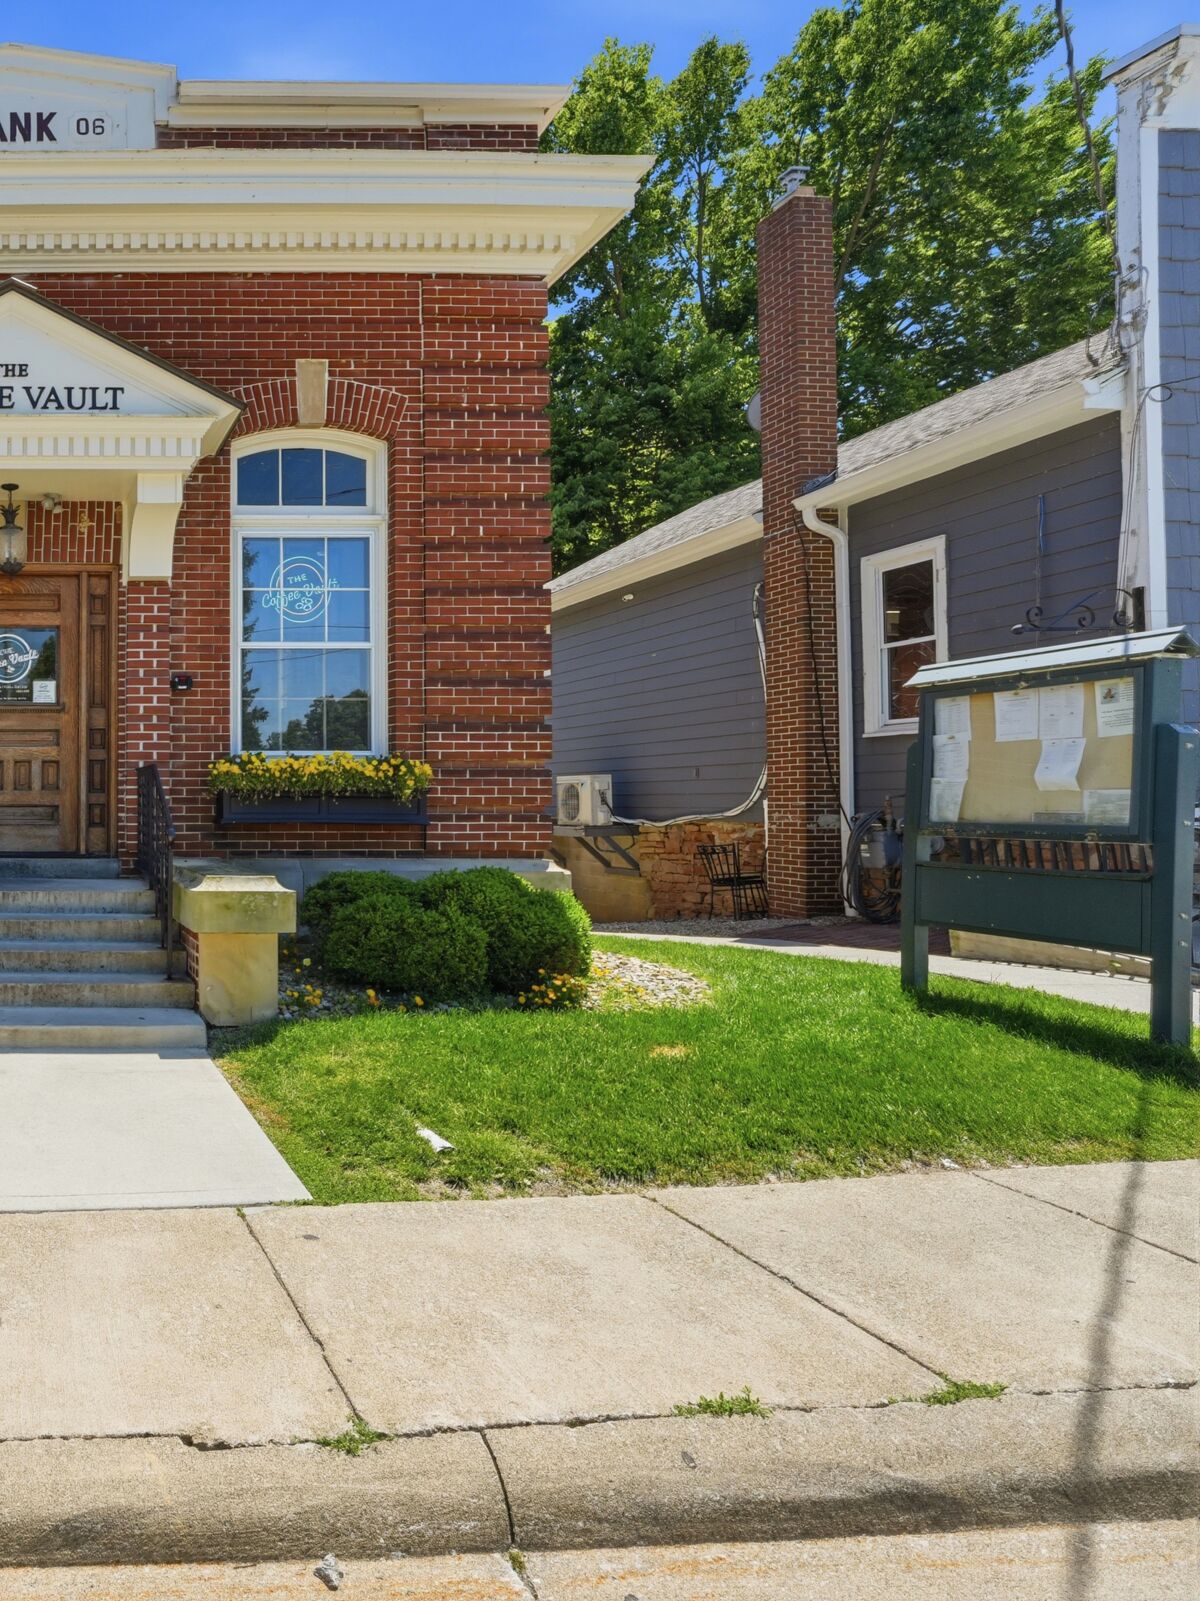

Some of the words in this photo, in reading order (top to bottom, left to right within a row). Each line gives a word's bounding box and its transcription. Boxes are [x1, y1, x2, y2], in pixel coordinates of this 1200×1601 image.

[76, 117, 105, 136] 06
[22, 386, 125, 411] VAULT
[287, 573, 309, 584] THE
[261, 590, 301, 608] Coffee
[8, 649, 40, 665] Vault
